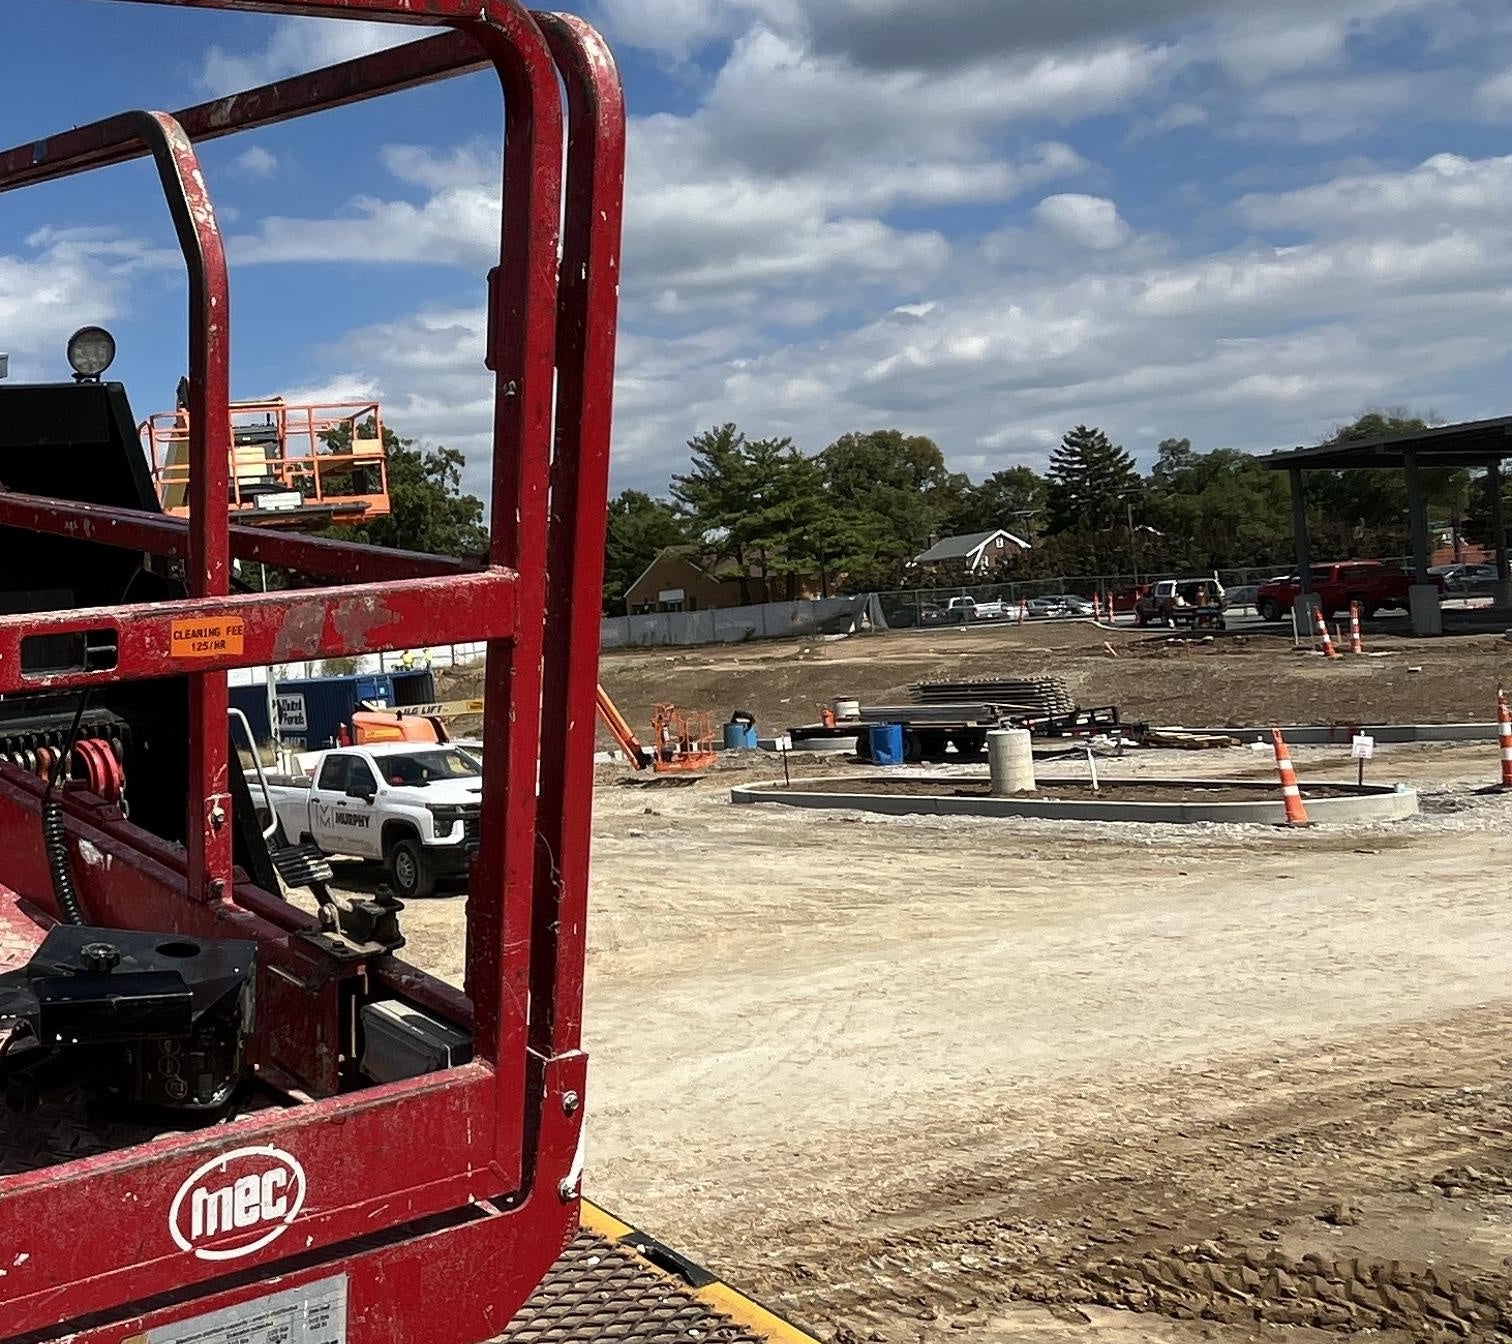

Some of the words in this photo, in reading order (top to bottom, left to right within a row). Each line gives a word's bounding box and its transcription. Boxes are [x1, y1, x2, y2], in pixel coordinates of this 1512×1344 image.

[173, 627, 221, 641] CLEANING
[226, 625, 244, 636] FEE
[191, 639, 226, 652] 125/HR
[335, 812, 370, 828] MURPHY
[191, 1167, 287, 1240] mec
